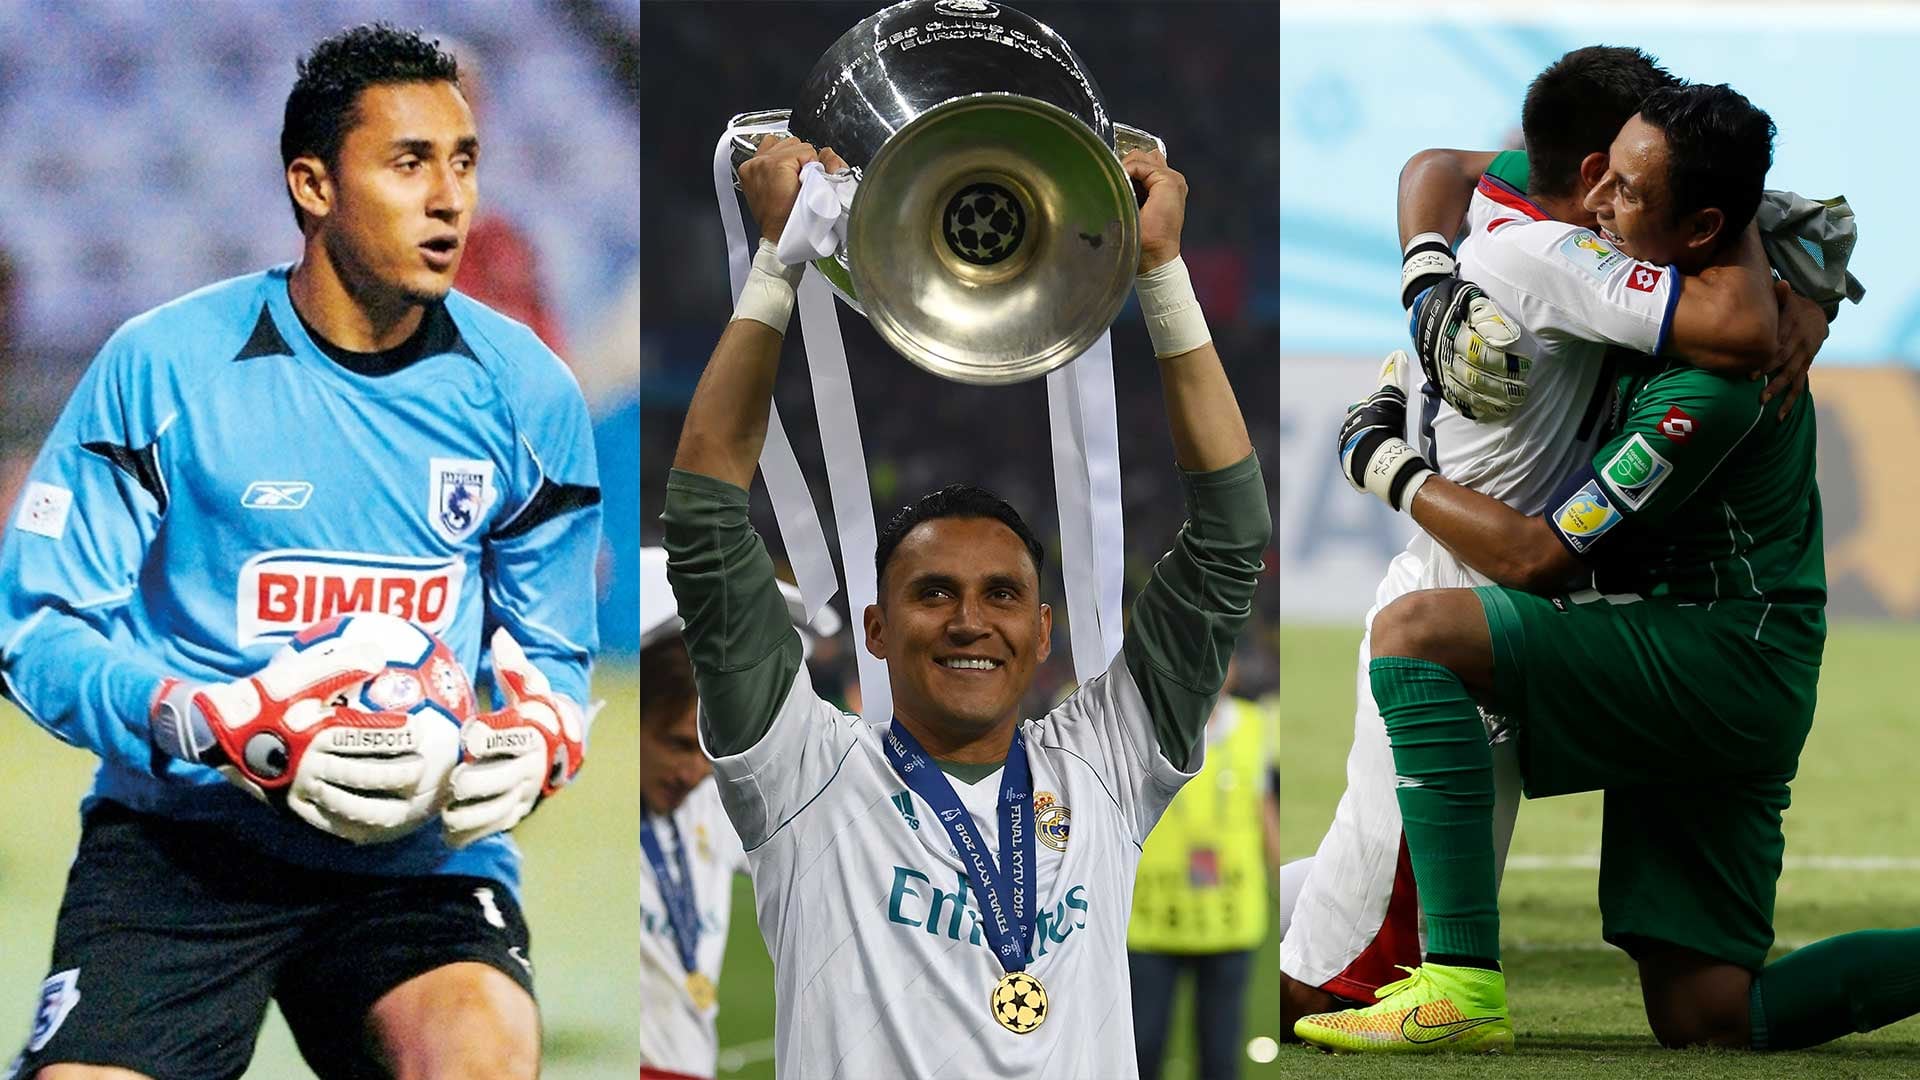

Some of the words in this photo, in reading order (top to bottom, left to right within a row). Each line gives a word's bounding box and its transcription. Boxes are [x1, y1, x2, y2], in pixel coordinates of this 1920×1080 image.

[257, 572, 449, 624] BIMBO
[331, 730, 414, 748] uhlsport
[954, 823, 976, 851] 2018
[1011, 804, 1022, 848] FINAL
[971, 852, 992, 888] KYIV
[1012, 850, 1024, 885] KYIV
[987, 888, 1010, 936] FINAL
